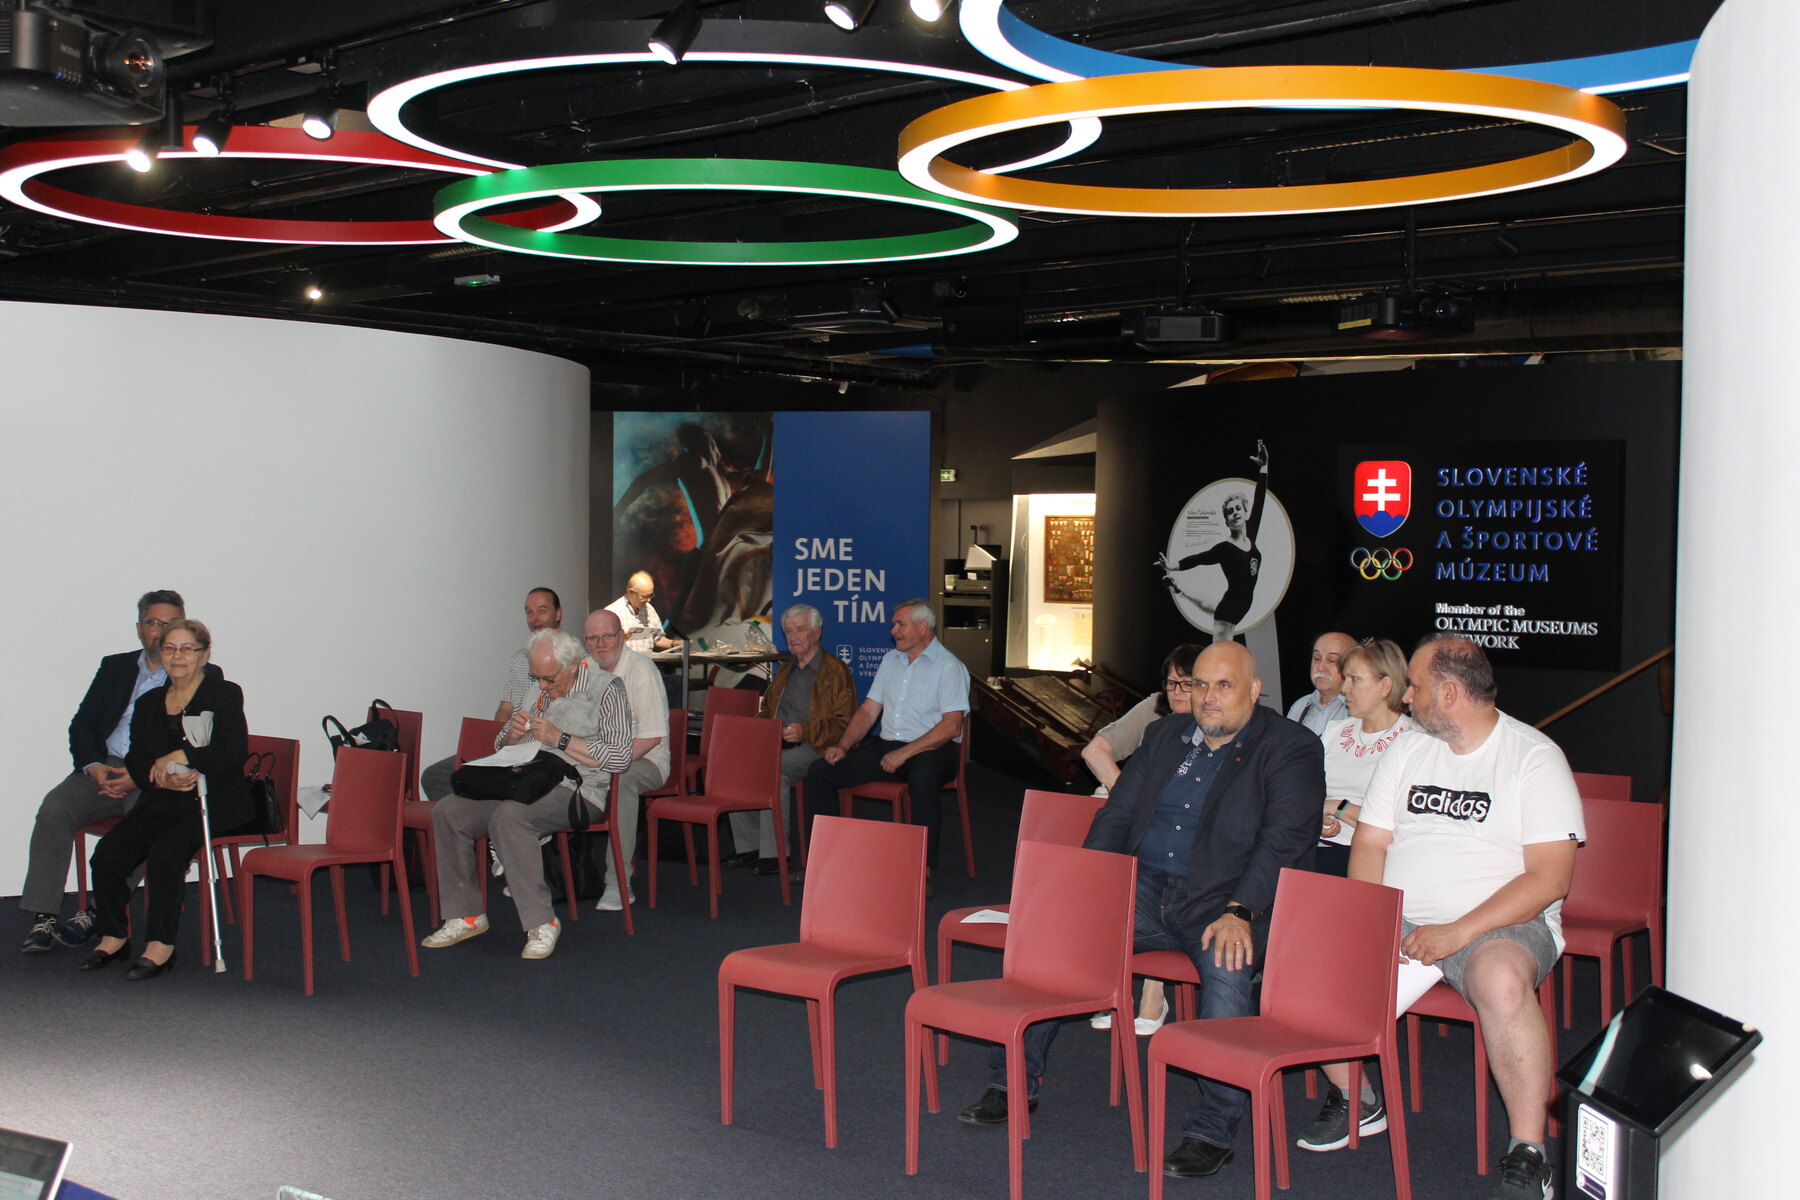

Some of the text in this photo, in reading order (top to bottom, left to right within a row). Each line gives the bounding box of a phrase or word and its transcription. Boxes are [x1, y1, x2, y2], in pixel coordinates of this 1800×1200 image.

[1437, 462, 1588, 487] SLOVENSKÉ
[1436, 494, 1593, 524] OLYMPIJSKÉ
[794, 537, 853, 561] SME
[1435, 526, 1599, 551] A ŠPORTOVÉ
[793, 568, 886, 597] JEDEN
[1435, 557, 1549, 583] MÚZEUM
[833, 594, 886, 623] TÍM
[1435, 602, 1526, 617] Member of the
[1435, 616, 1598, 636] OLYMPIC MUSEUMS
[1411, 790, 1489, 818] adidas
